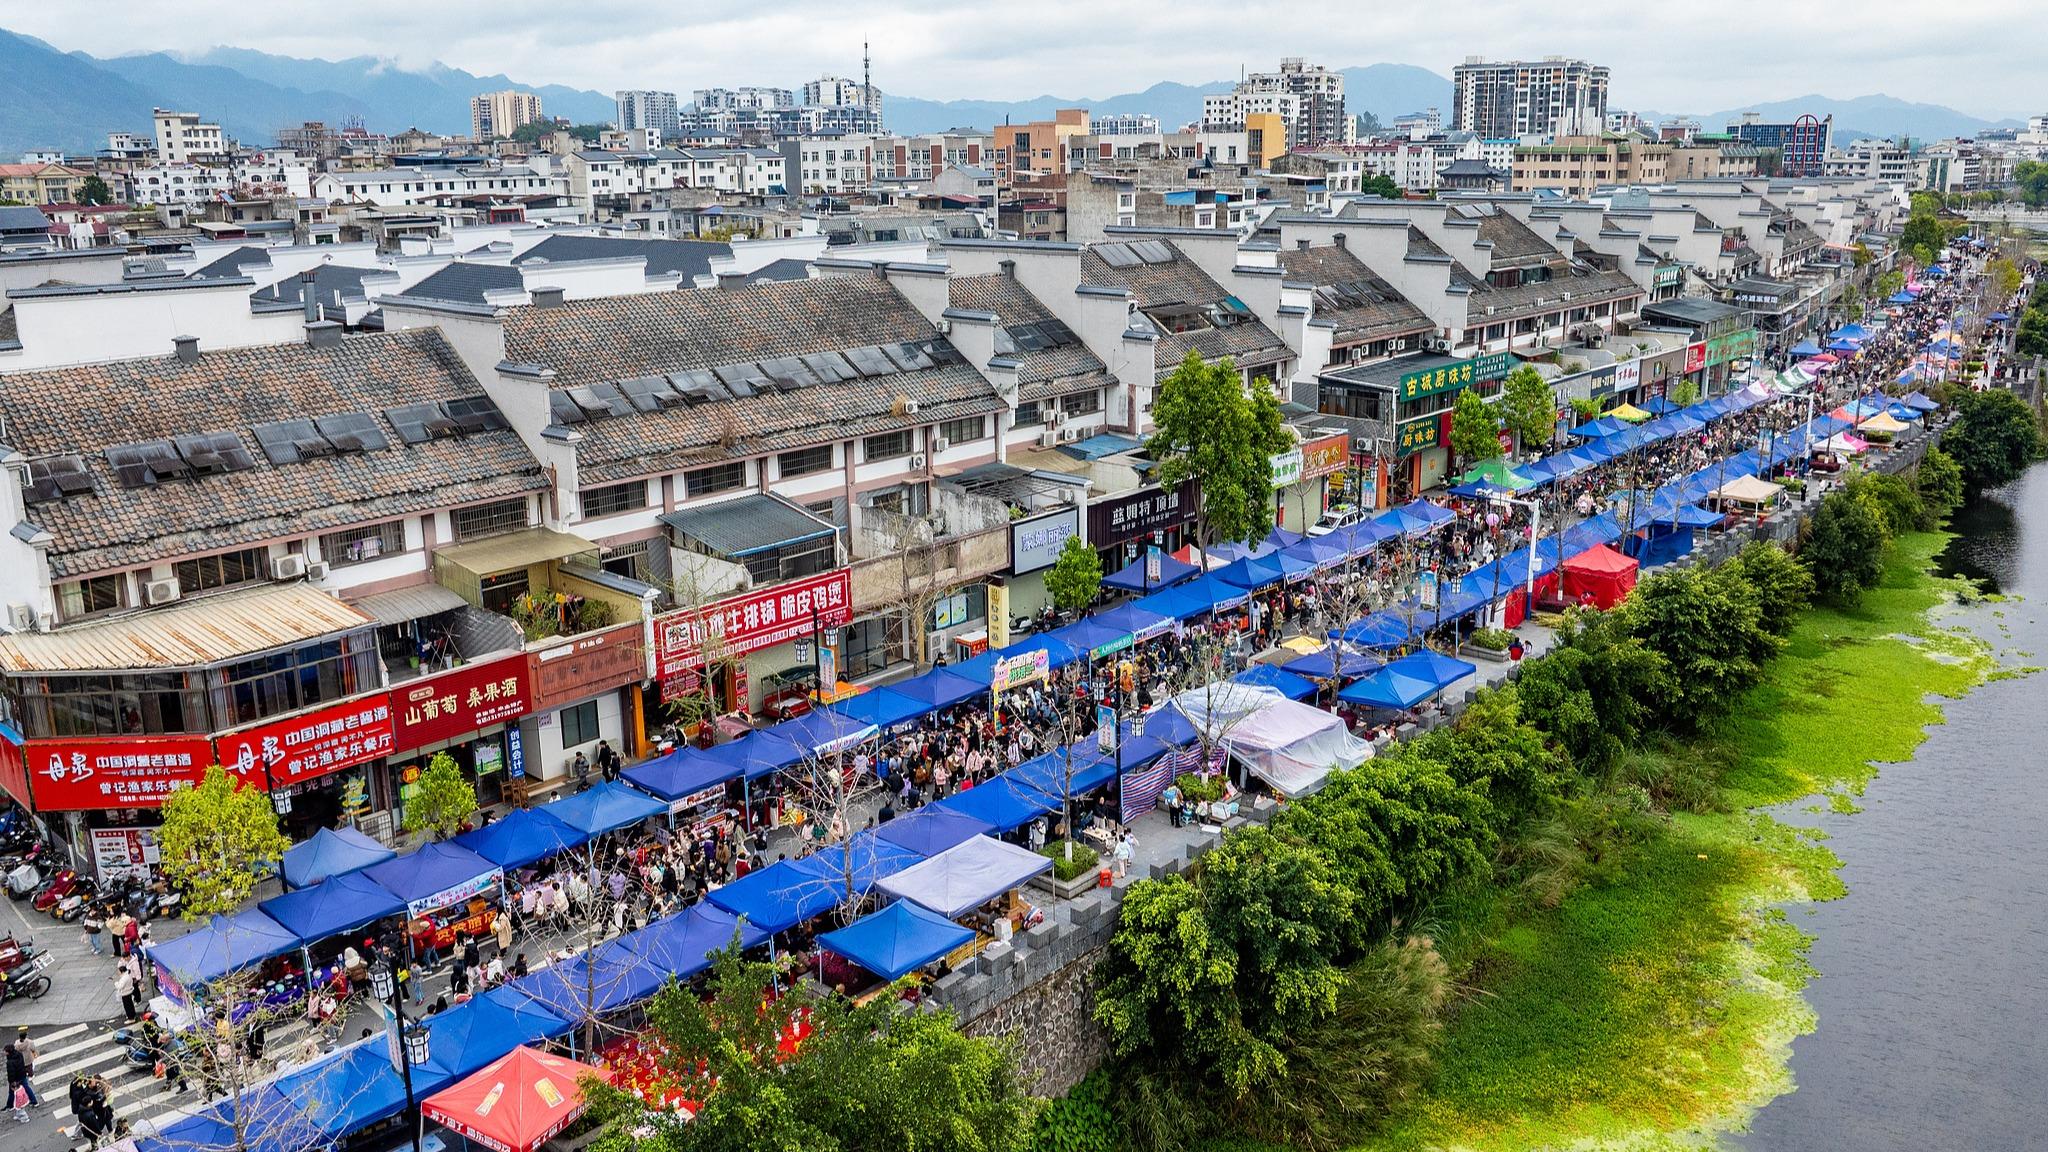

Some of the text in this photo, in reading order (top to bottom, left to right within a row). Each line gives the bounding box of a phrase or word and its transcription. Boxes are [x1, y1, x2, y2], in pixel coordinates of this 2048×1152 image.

[781, 580, 842, 620] 脆皮鸡煲
[405, 694, 458, 726] 山葡萄
[467, 677, 518, 708] 桑果酒
[285, 705, 389, 746] 中国洞藏老酱酒
[39, 752, 94, 783] 丹泉
[96, 753, 192, 769] 中国洞藏老酱酒
[226, 736, 286, 775] 丹泉
[288, 733, 392, 775] 曾记渔家乐餐厅
